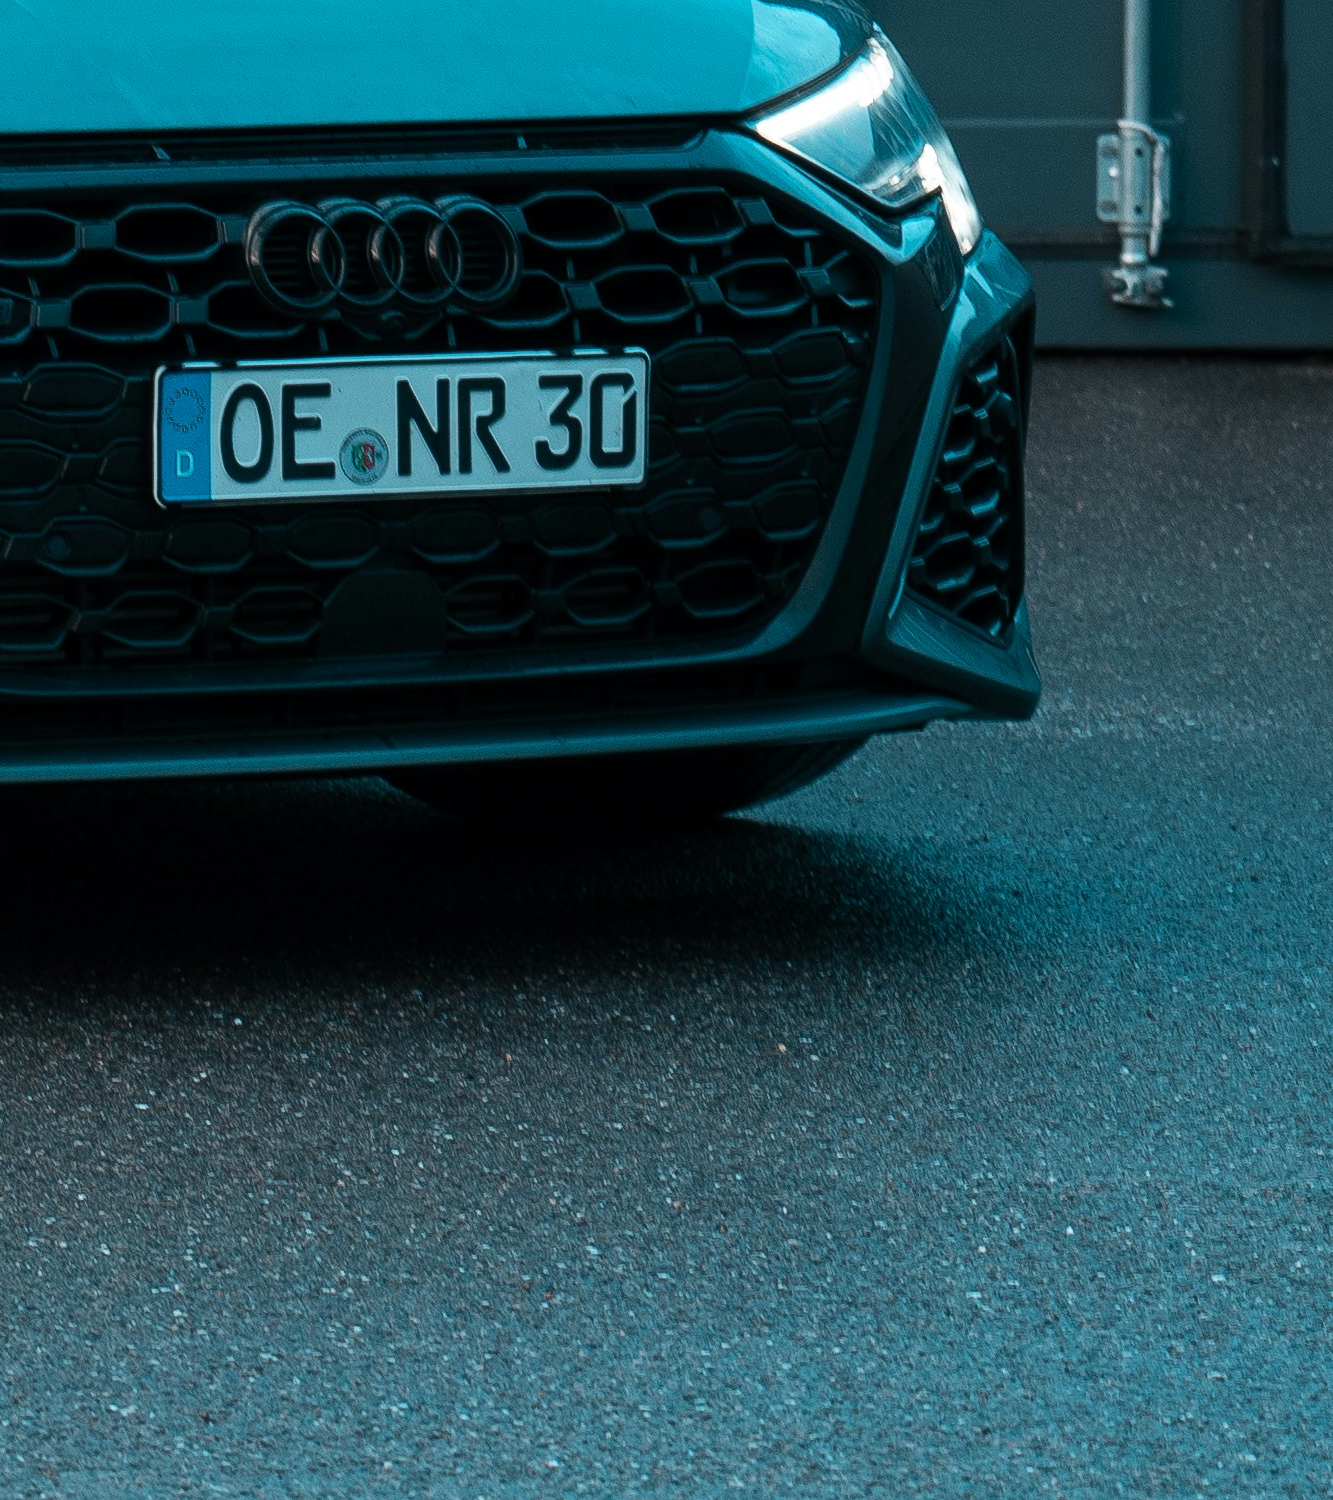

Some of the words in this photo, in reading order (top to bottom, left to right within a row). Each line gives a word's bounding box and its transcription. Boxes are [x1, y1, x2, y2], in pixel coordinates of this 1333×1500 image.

[219, 378, 337, 484] OE
[395, 375, 511, 478] NR
[534, 371, 639, 471] 30
[175, 450, 195, 480] D
